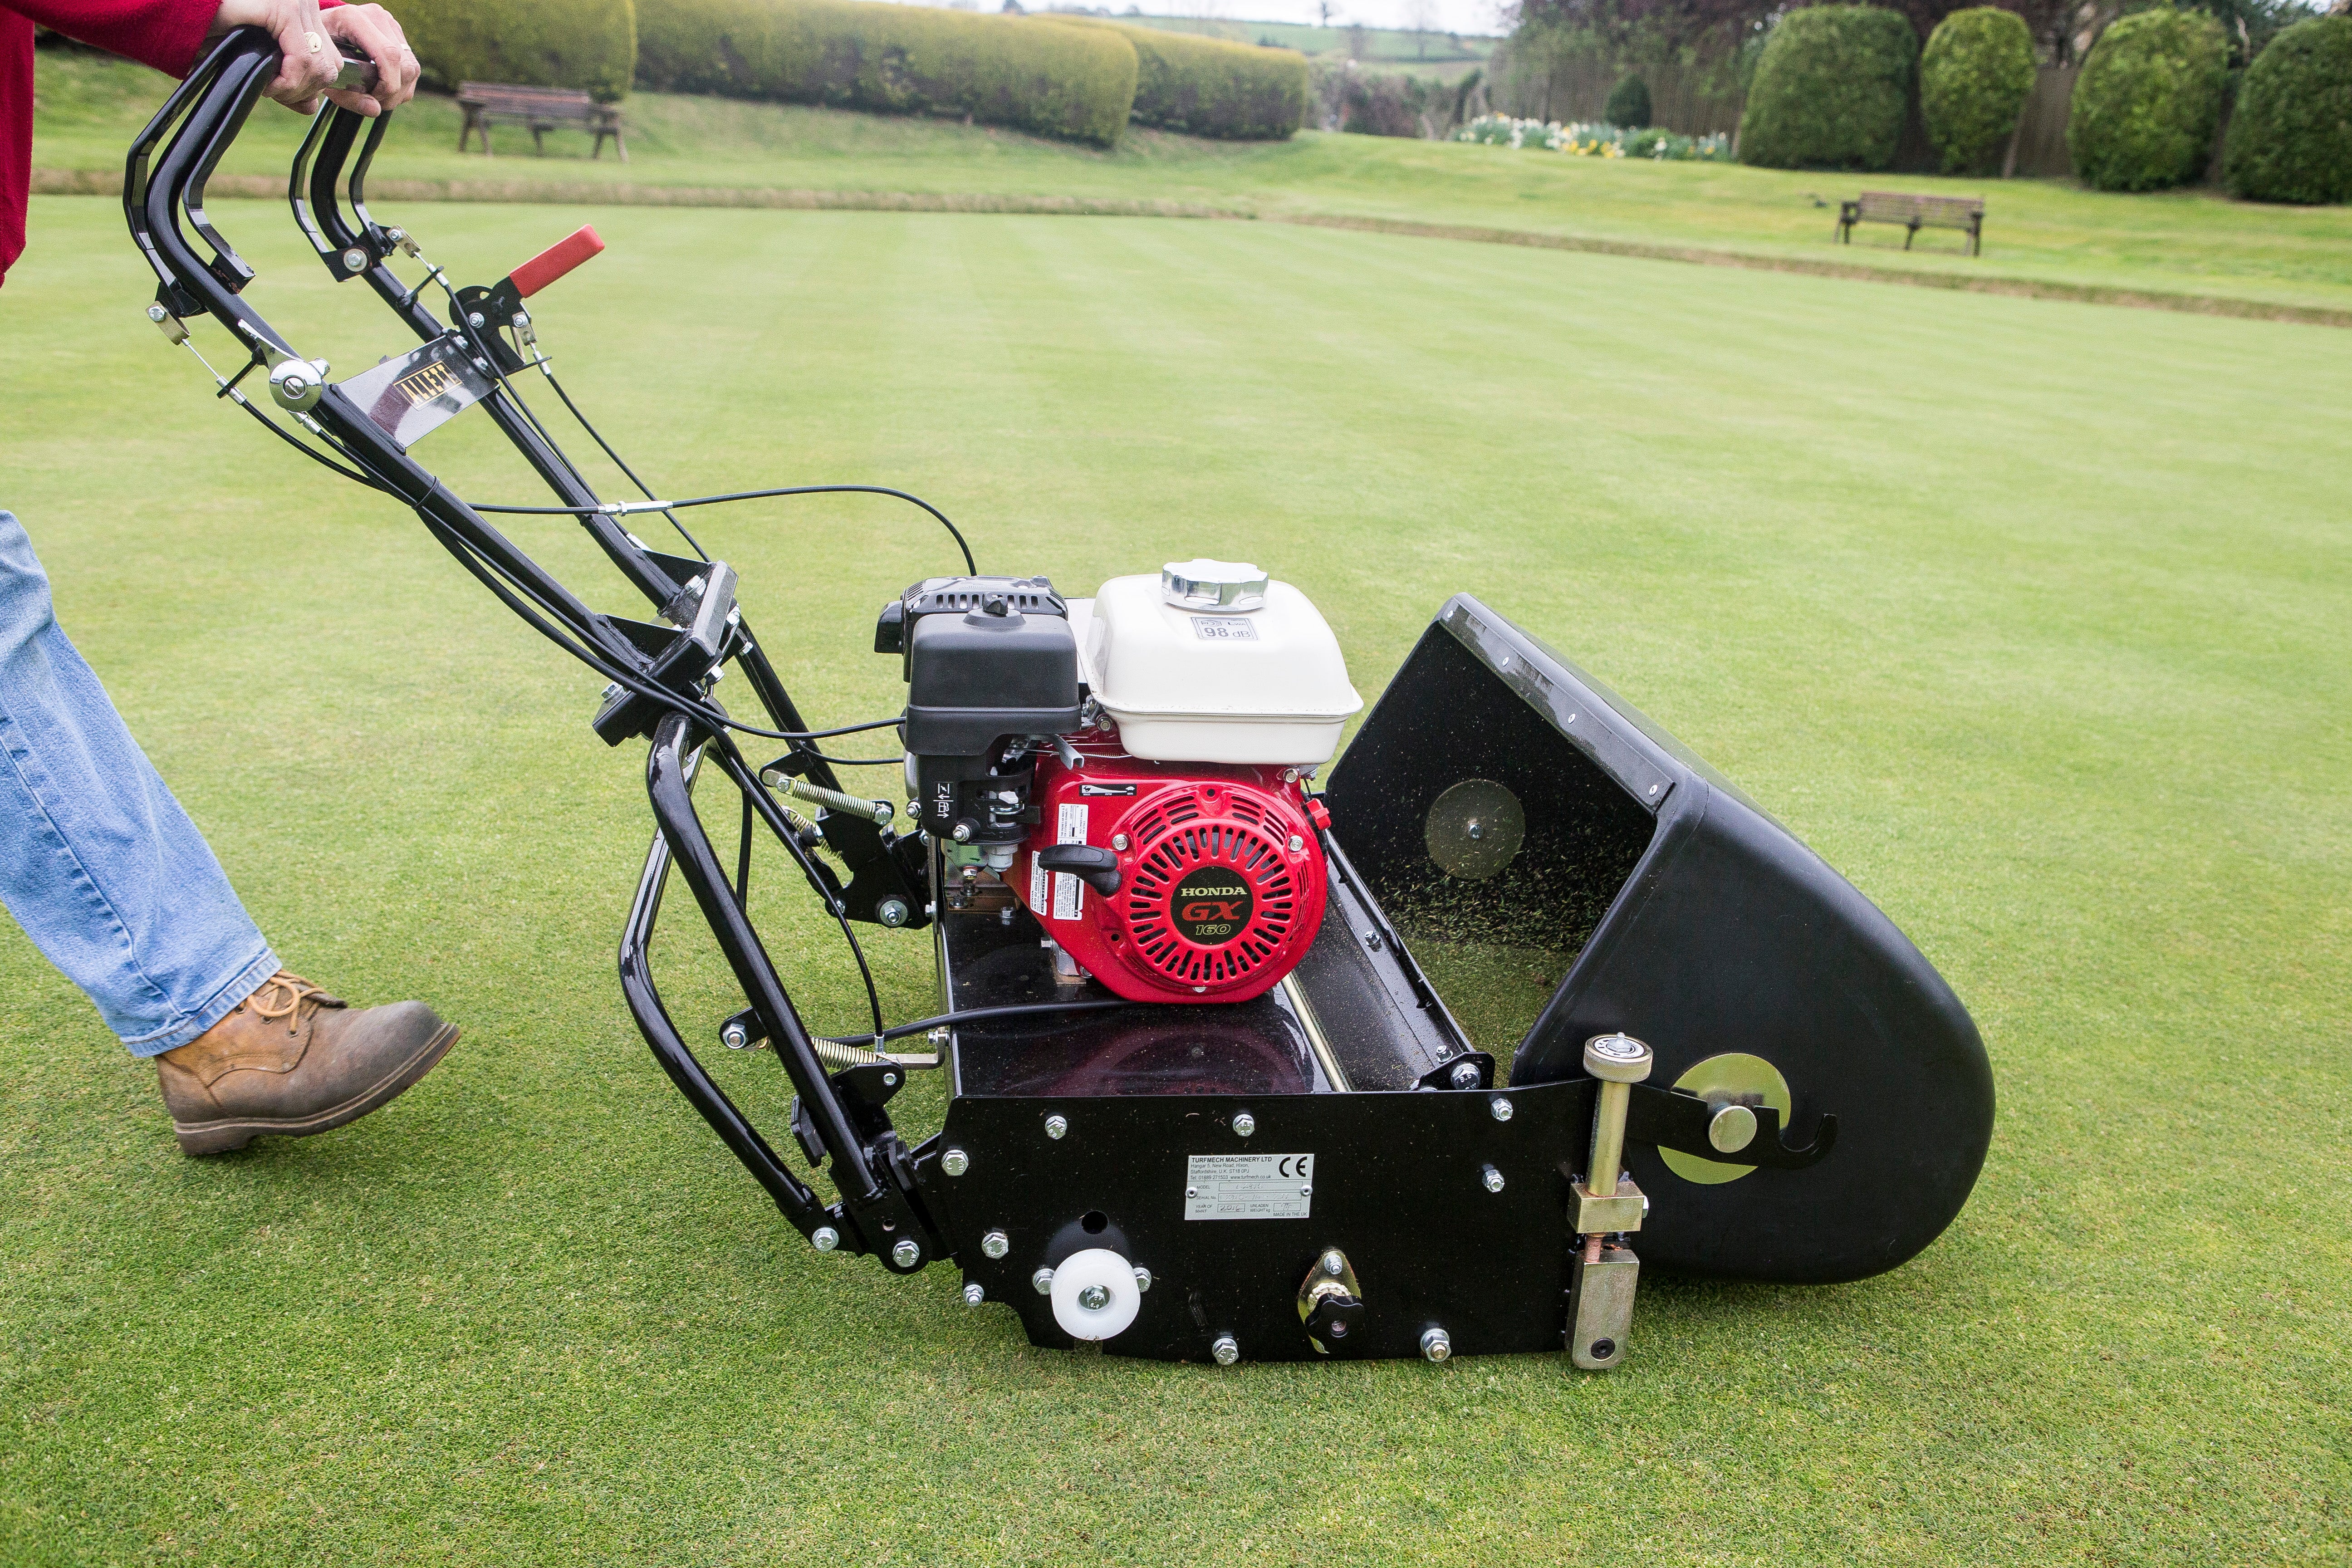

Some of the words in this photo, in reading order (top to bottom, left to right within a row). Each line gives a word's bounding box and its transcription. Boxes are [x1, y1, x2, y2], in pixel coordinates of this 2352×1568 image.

[401, 364, 456, 405] ALLETT
[1204, 627, 1229, 637] 98
[1181, 887, 1247, 896] HONDA
[1181, 901, 1244, 921] GX
[1196, 924, 1231, 935] 160
